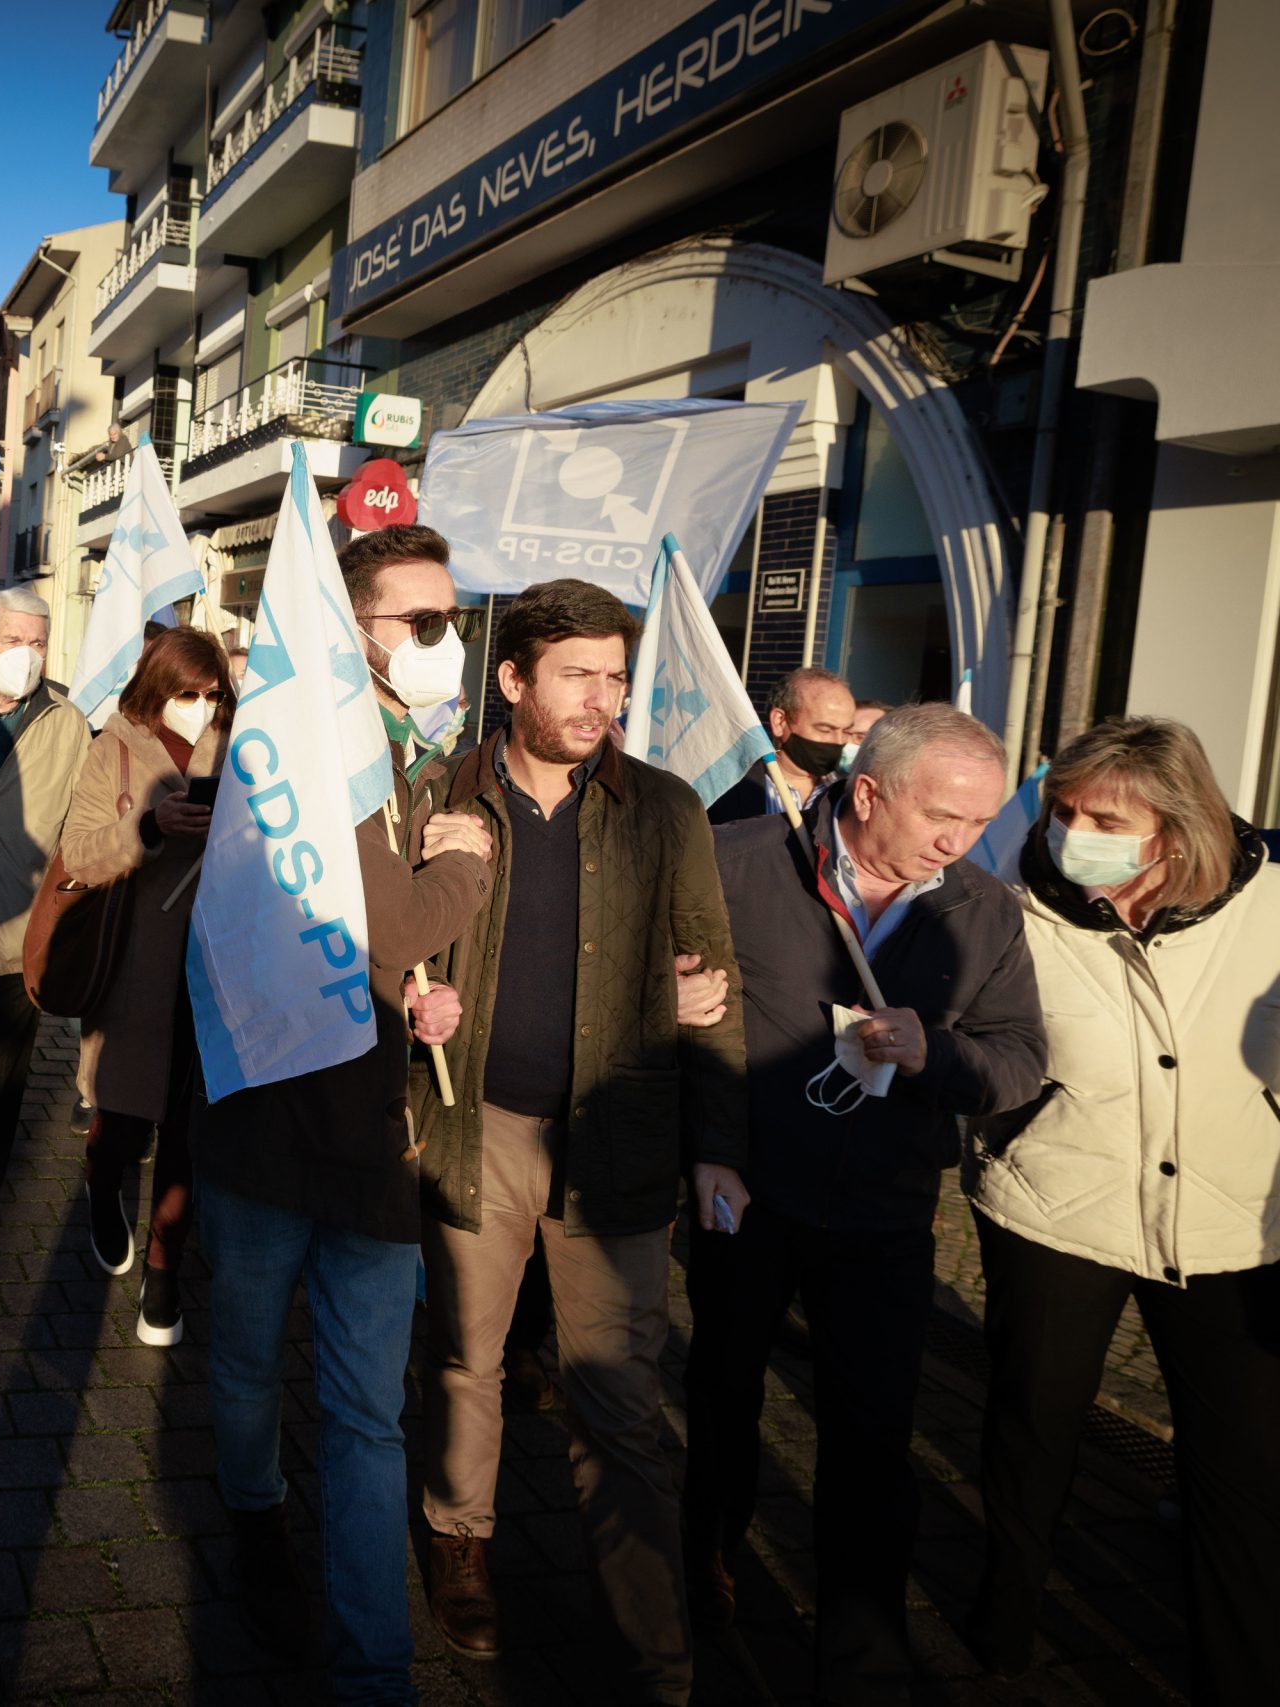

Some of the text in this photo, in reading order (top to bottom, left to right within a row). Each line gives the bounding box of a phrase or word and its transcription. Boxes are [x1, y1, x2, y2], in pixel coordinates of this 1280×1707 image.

[410, 192, 466, 257] DAS
[478, 115, 596, 216] NEVES,
[363, 485, 399, 514] edp
[230, 728, 372, 1025] CDS-PP
